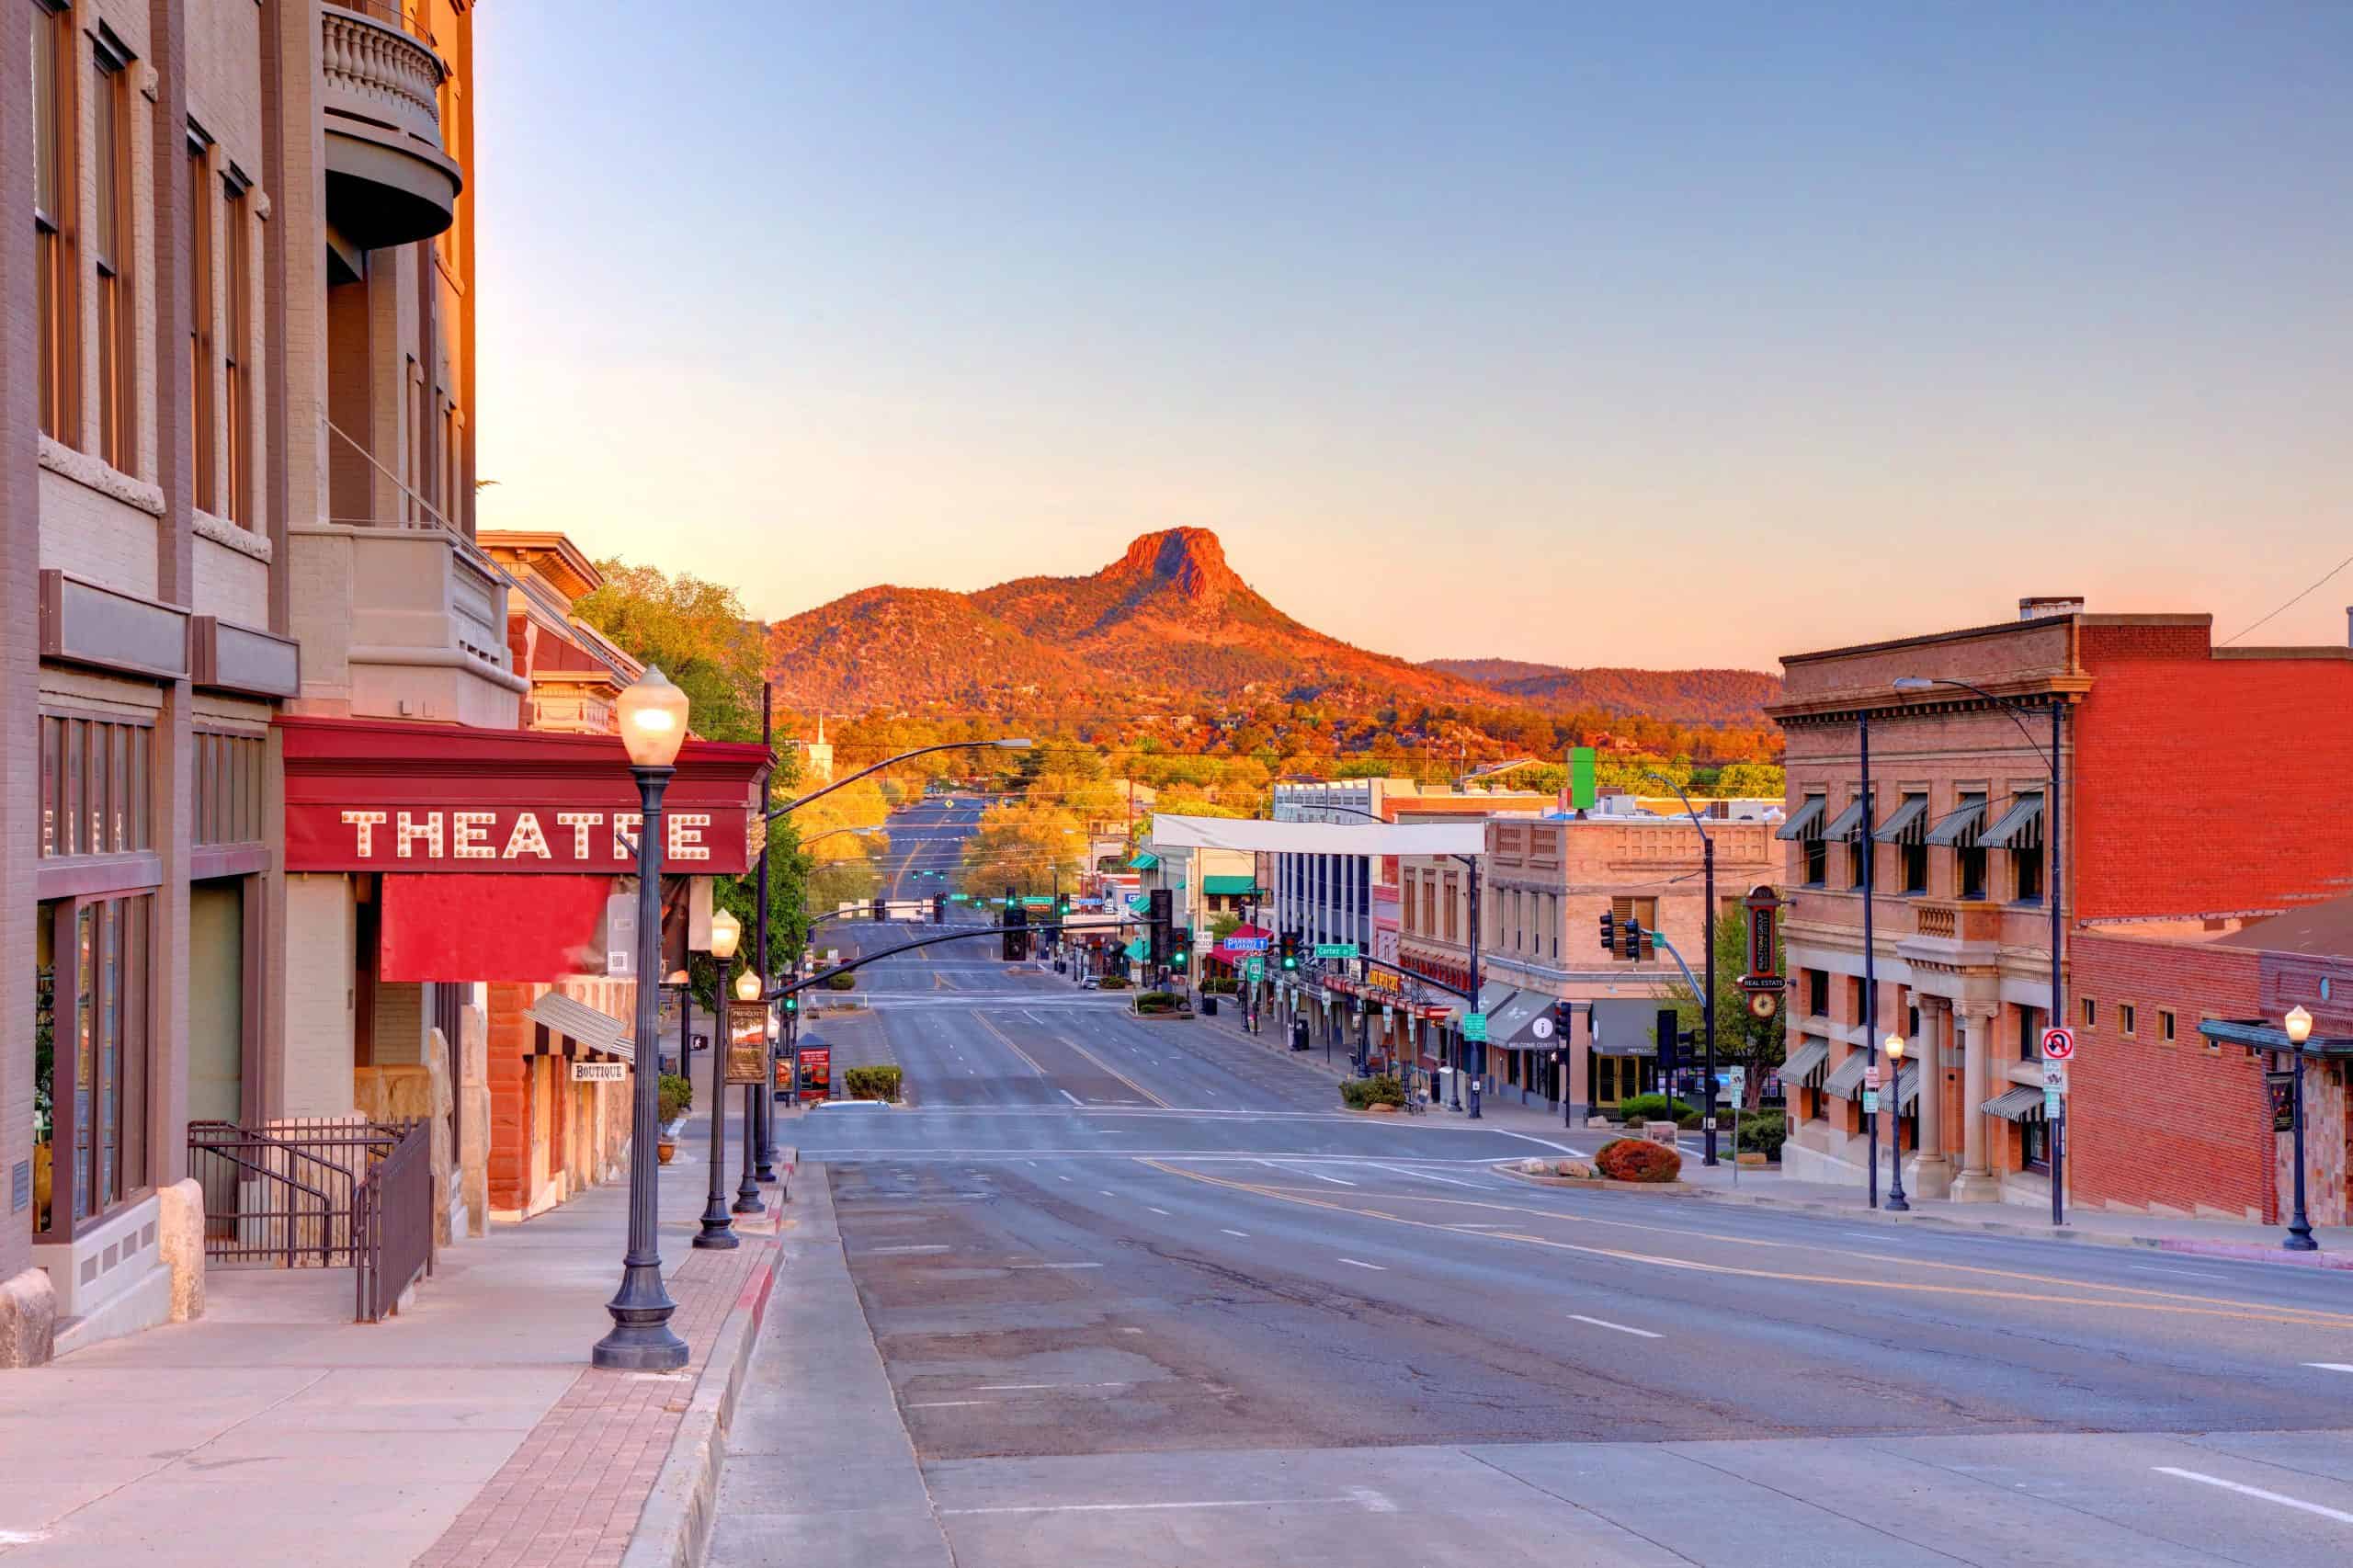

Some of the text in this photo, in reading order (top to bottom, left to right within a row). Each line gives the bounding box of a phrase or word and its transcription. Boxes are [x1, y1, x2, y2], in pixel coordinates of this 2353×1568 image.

[341, 811, 710, 860] THEATRE
[1744, 978, 1784, 986] REAL ESTATE
[576, 1065, 622, 1080] BOUTIQUE
